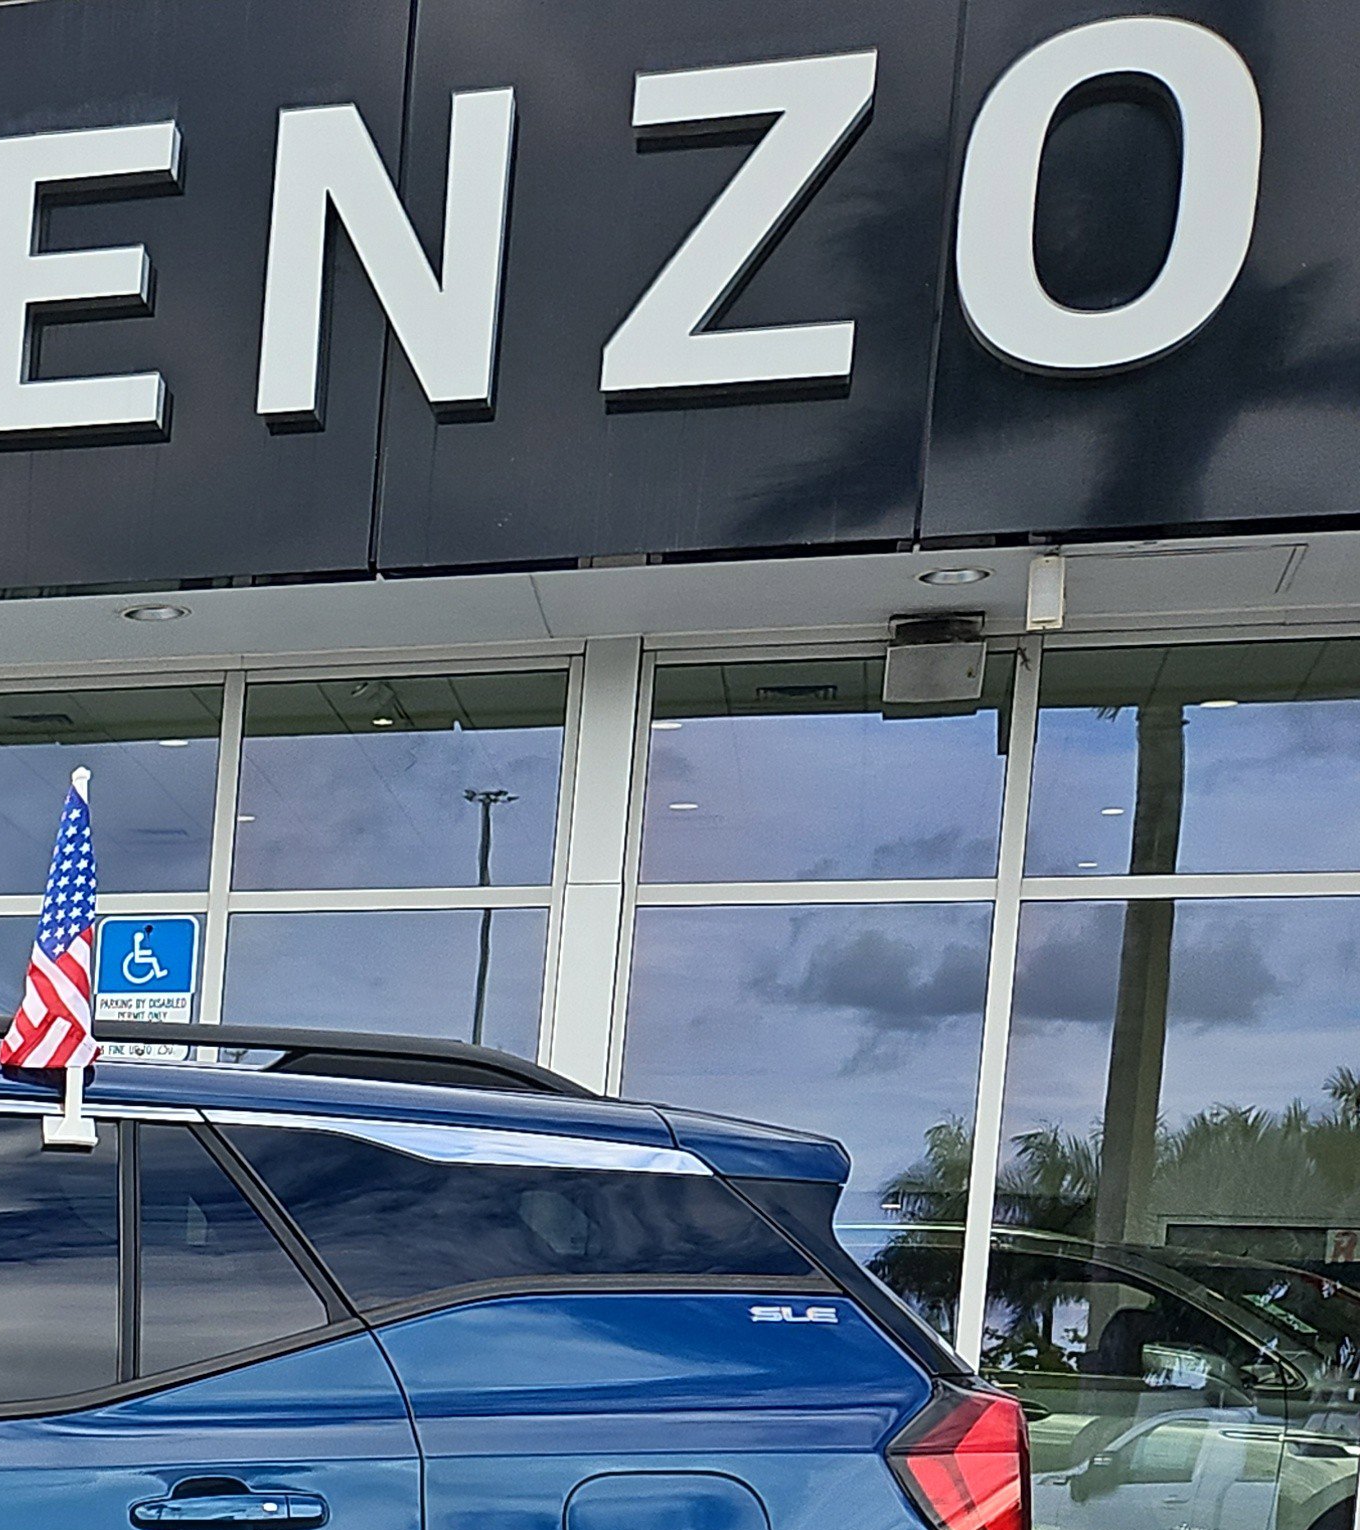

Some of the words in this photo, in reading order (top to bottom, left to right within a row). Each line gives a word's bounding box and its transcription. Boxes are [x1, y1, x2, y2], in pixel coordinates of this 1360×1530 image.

[100, 998, 133, 1010] PARKING
[135, 999, 146, 1009] BY
[148, 997, 187, 1009] DISABLED
[117, 1011, 146, 1020] PERMIT
[147, 1011, 168, 1020] ONLY
[748, 1306, 838, 1323] SLE
